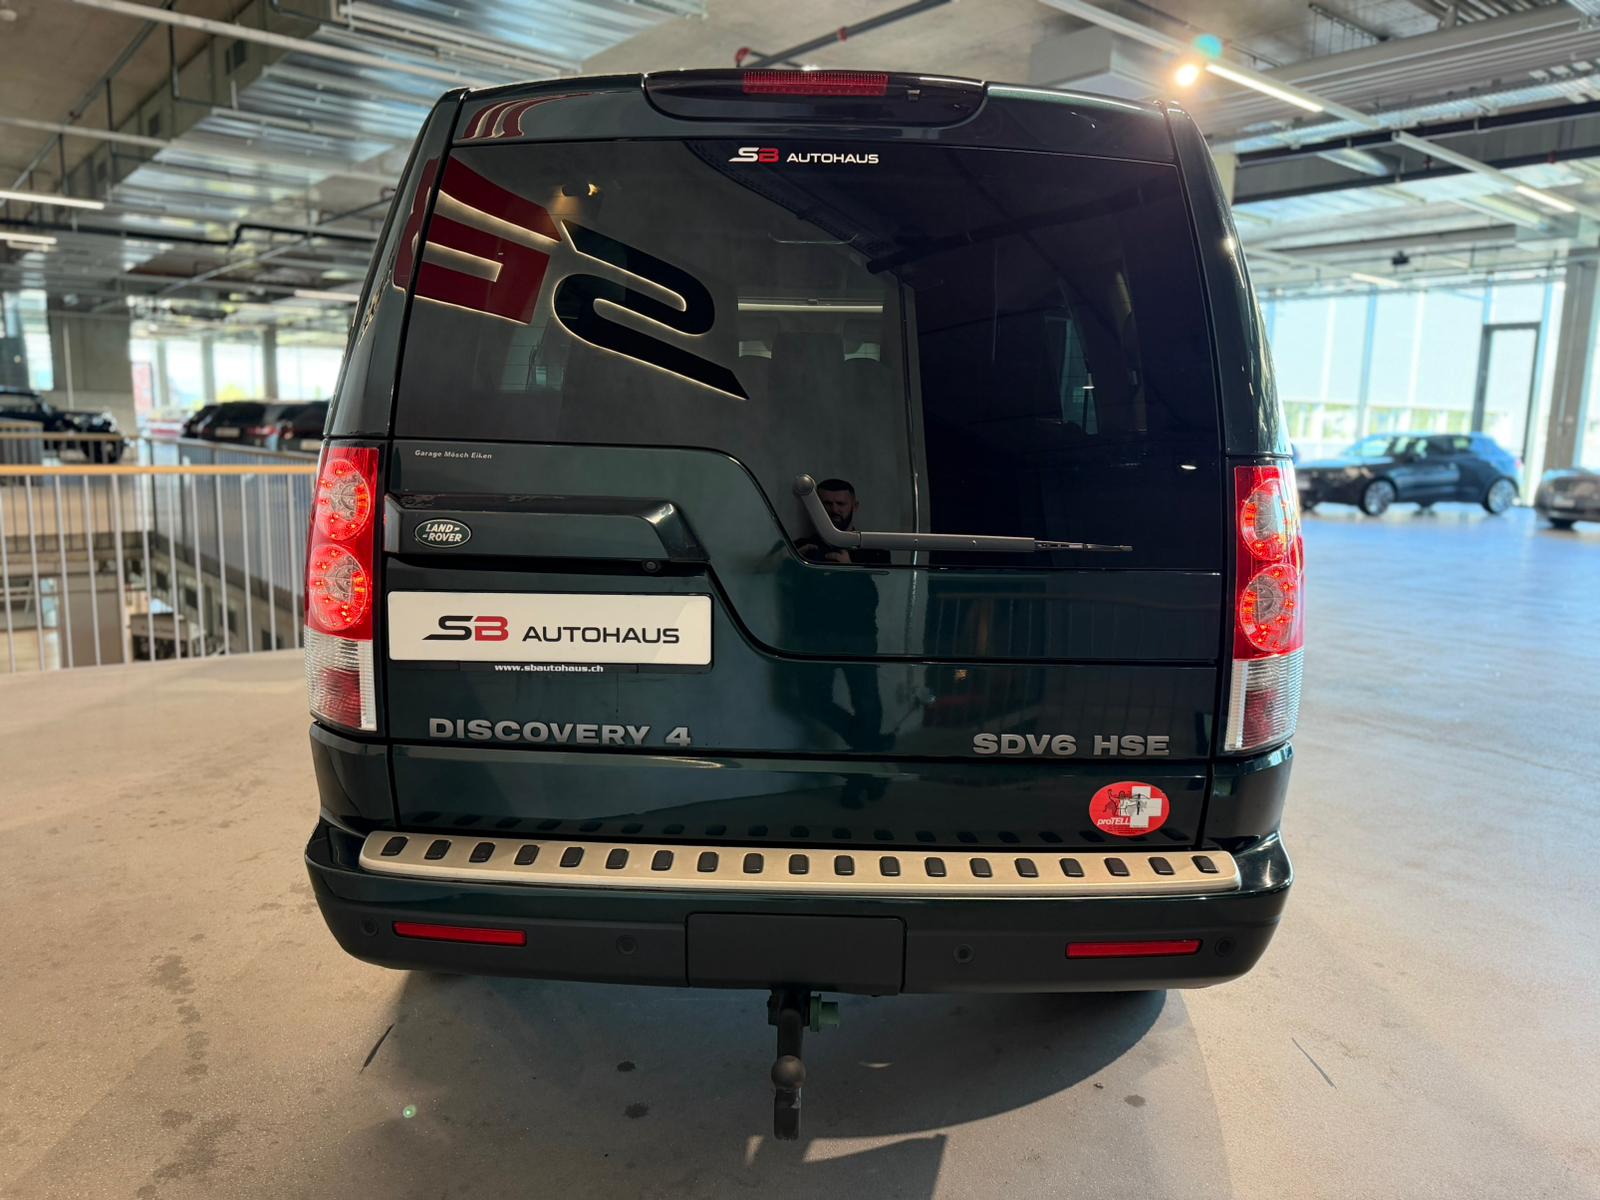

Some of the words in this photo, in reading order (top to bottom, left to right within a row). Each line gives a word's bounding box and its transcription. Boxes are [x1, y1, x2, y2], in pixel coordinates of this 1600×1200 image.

[728, 147, 780, 163] SB
[786, 153, 880, 164] AUTOHAUS
[414, 449, 442, 458] Garage
[421, 615, 509, 642] SB
[521, 626, 680, 644] AUTOHAUS
[494, 664, 604, 673] www.sbautohaus.ch
[429, 717, 651, 746] DISCOVERY
[665, 726, 692, 747] 4
[973, 733, 1077, 755] SDV6
[1093, 735, 1170, 756] HSE
[1097, 816, 1131, 827] proTELL
